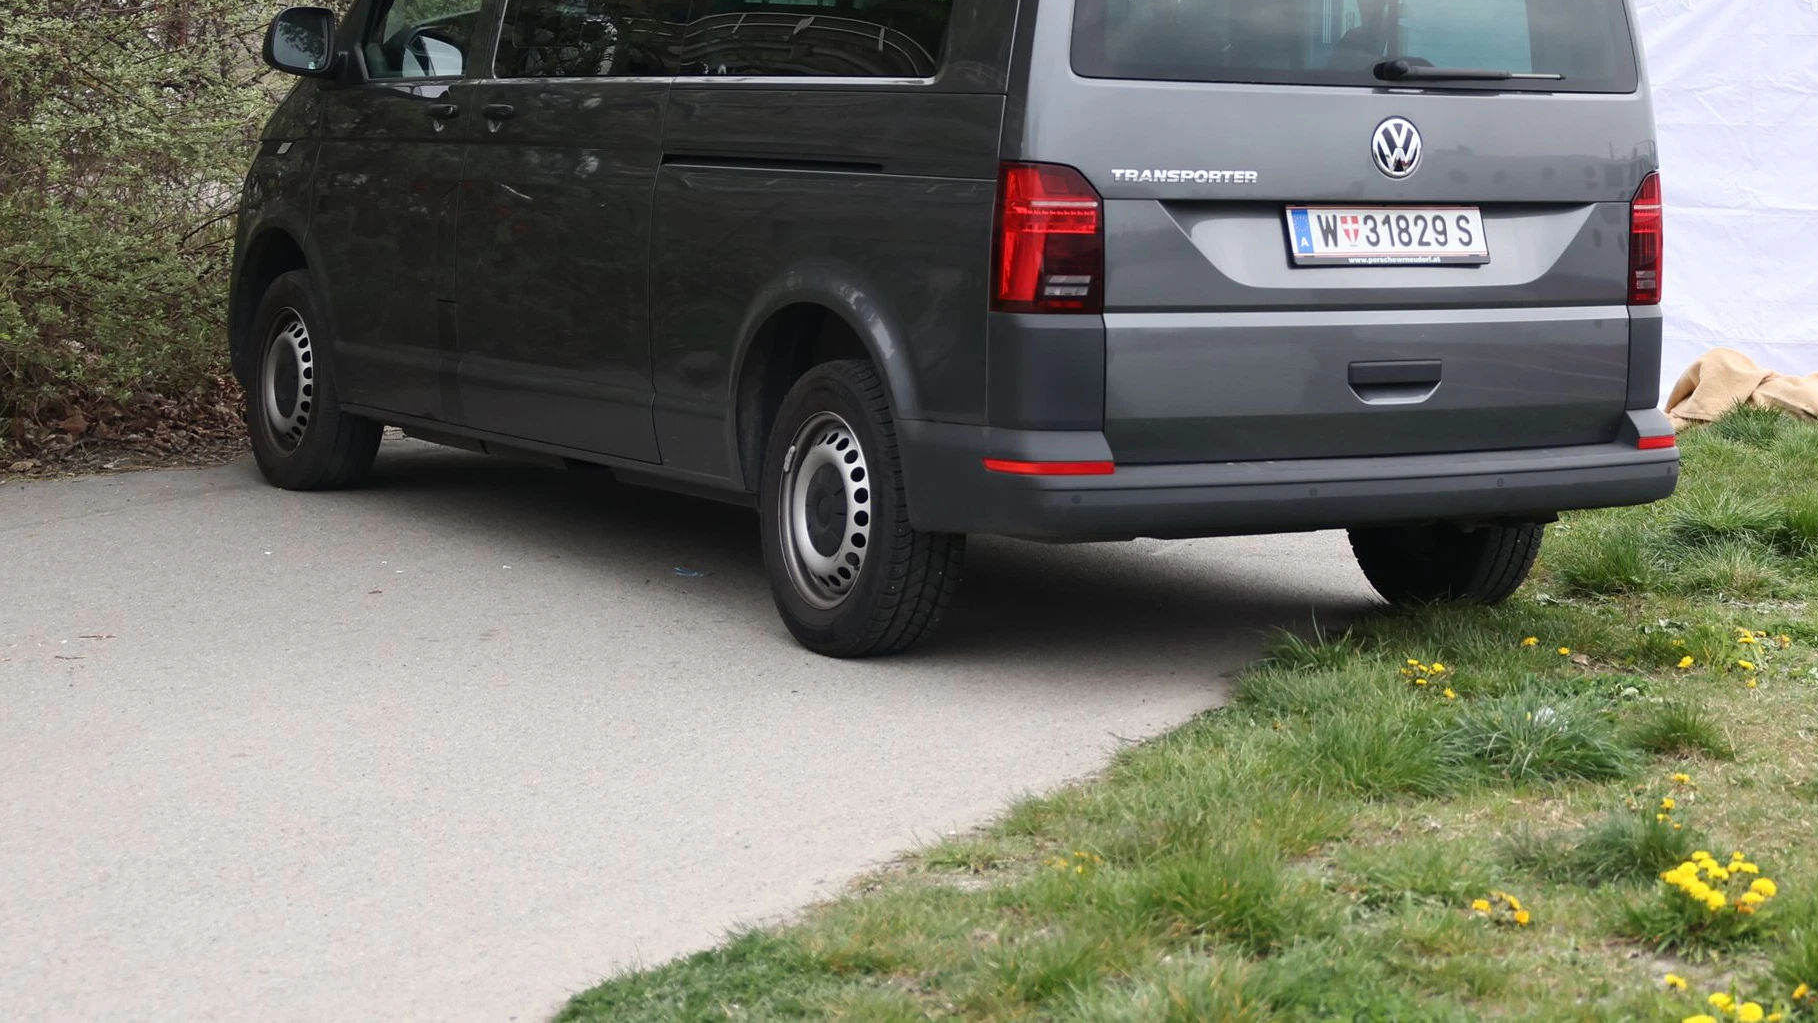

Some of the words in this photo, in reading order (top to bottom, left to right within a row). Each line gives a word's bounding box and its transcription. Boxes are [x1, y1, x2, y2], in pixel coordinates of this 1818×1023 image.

[1111, 169, 1258, 183] TRANSPORTER
[1317, 214, 1338, 248] W
[1363, 214, 1448, 247] 31829
[1456, 214, 1473, 247] S
[1300, 237, 1309, 247] A
